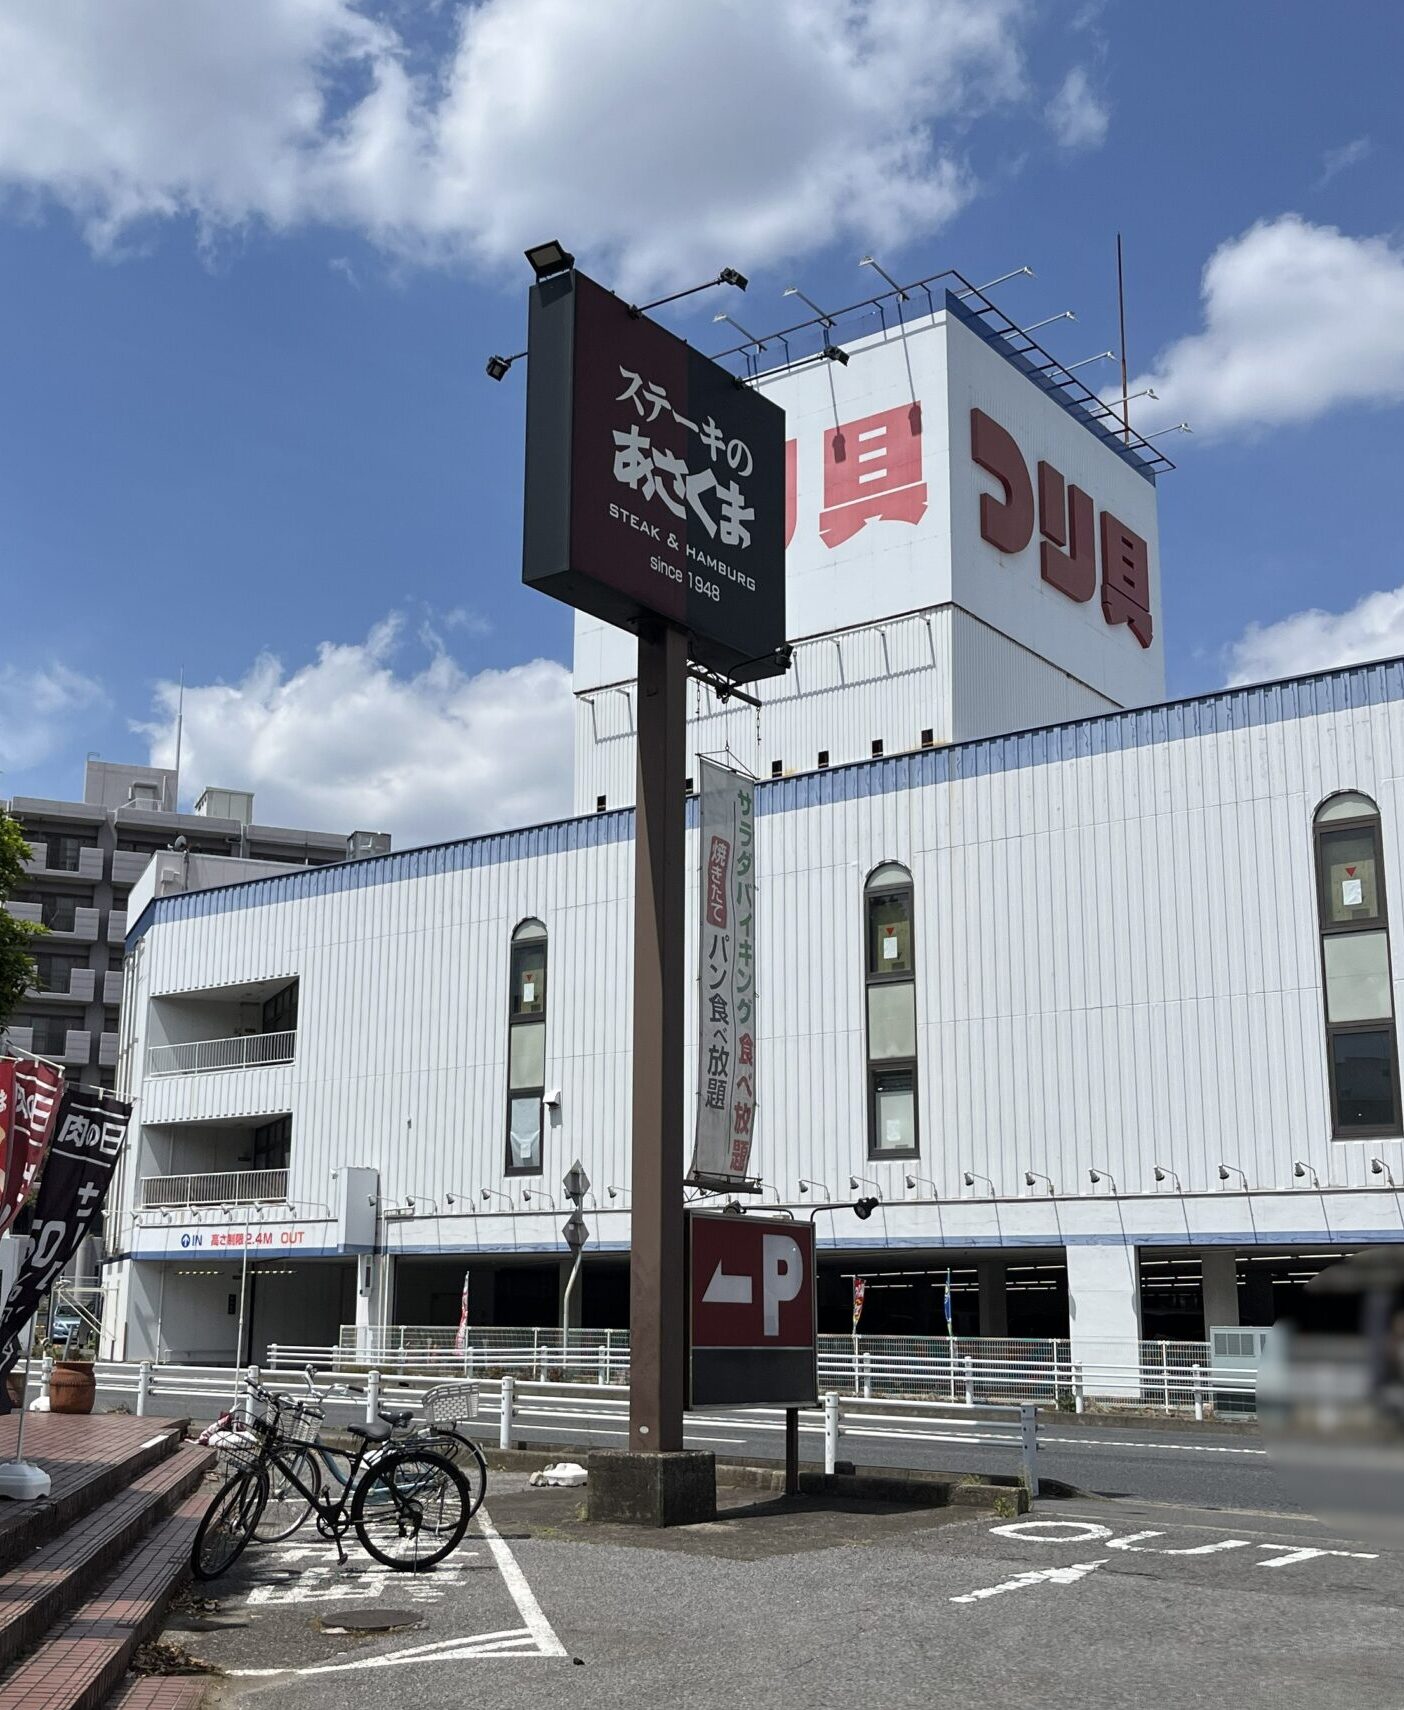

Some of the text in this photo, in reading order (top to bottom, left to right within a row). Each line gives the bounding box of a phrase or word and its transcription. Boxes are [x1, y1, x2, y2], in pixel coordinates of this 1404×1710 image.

[615, 364, 753, 477] ステーキの
[612, 424, 755, 549] あさくま
[970, 407, 1153, 649] つり具
[609, 503, 756, 592] STEAK & HAMBURG
[650, 556, 720, 602] since 1948
[57, 1114, 127, 1156] 肉の日
[192, 1234, 203, 1246] IN
[280, 1231, 305, 1244] OUT
[763, 1234, 804, 1336] P
[988, 1521, 1380, 1567] OUT
